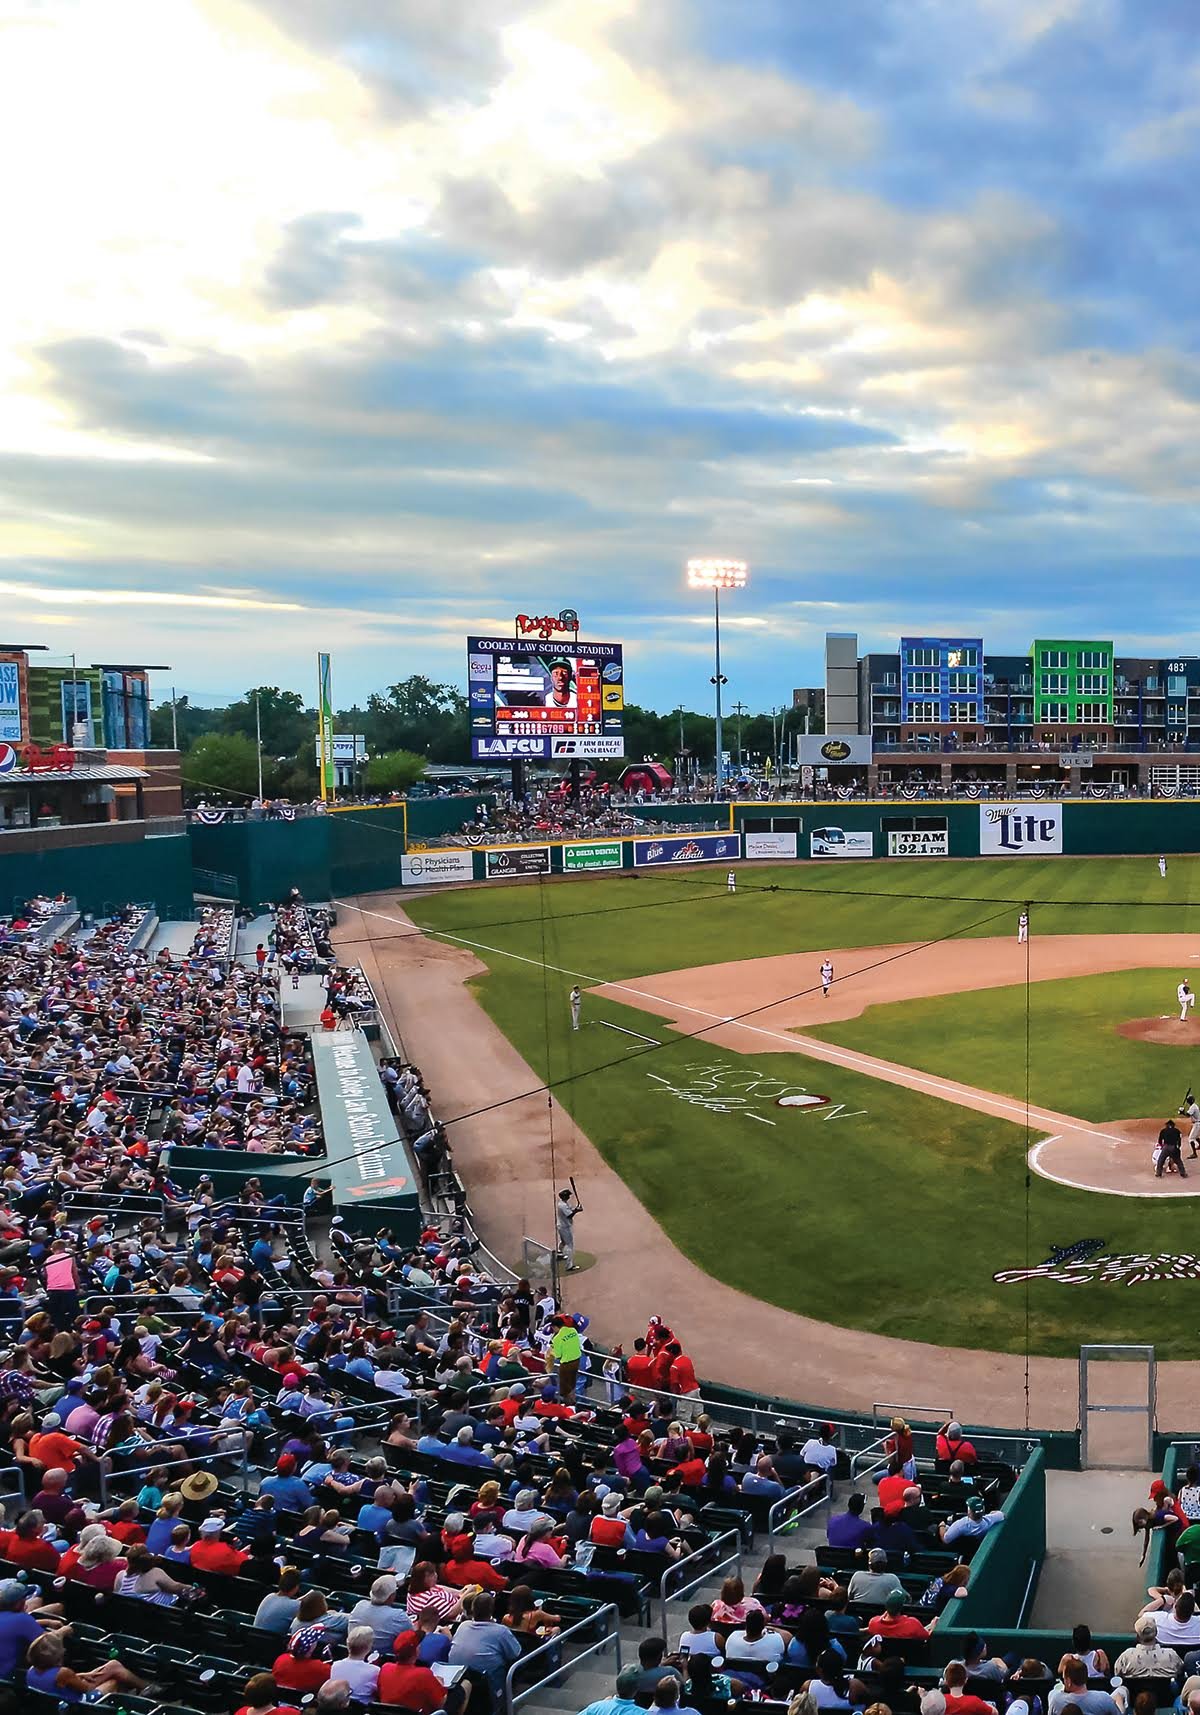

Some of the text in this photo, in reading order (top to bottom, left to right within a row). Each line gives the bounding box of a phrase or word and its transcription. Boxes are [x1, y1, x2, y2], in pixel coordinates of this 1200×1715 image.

[478, 640, 614, 656] COOLEY LAW SCHOOL STADIUM
[1168, 662, 1187, 672] 483'
[478, 739, 544, 753] LAFCU
[985, 807, 1017, 824] Miller
[901, 833, 945, 842] TEAM
[998, 815, 1056, 850] Lite
[576, 848, 619, 856] DELTA DENTAL
[647, 848, 664, 861] Blue
[671, 849, 704, 860] Labatt
[899, 844, 928, 854] 92.1
[425, 857, 460, 867] Physicians
[332, 1044, 360, 1069] Welcome
[338, 1069, 362, 1077] to
[336, 1076, 370, 1098] Cooley
[344, 1097, 373, 1114] Law
[349, 1113, 384, 1141] School
[353, 1140, 391, 1180] Stadium
